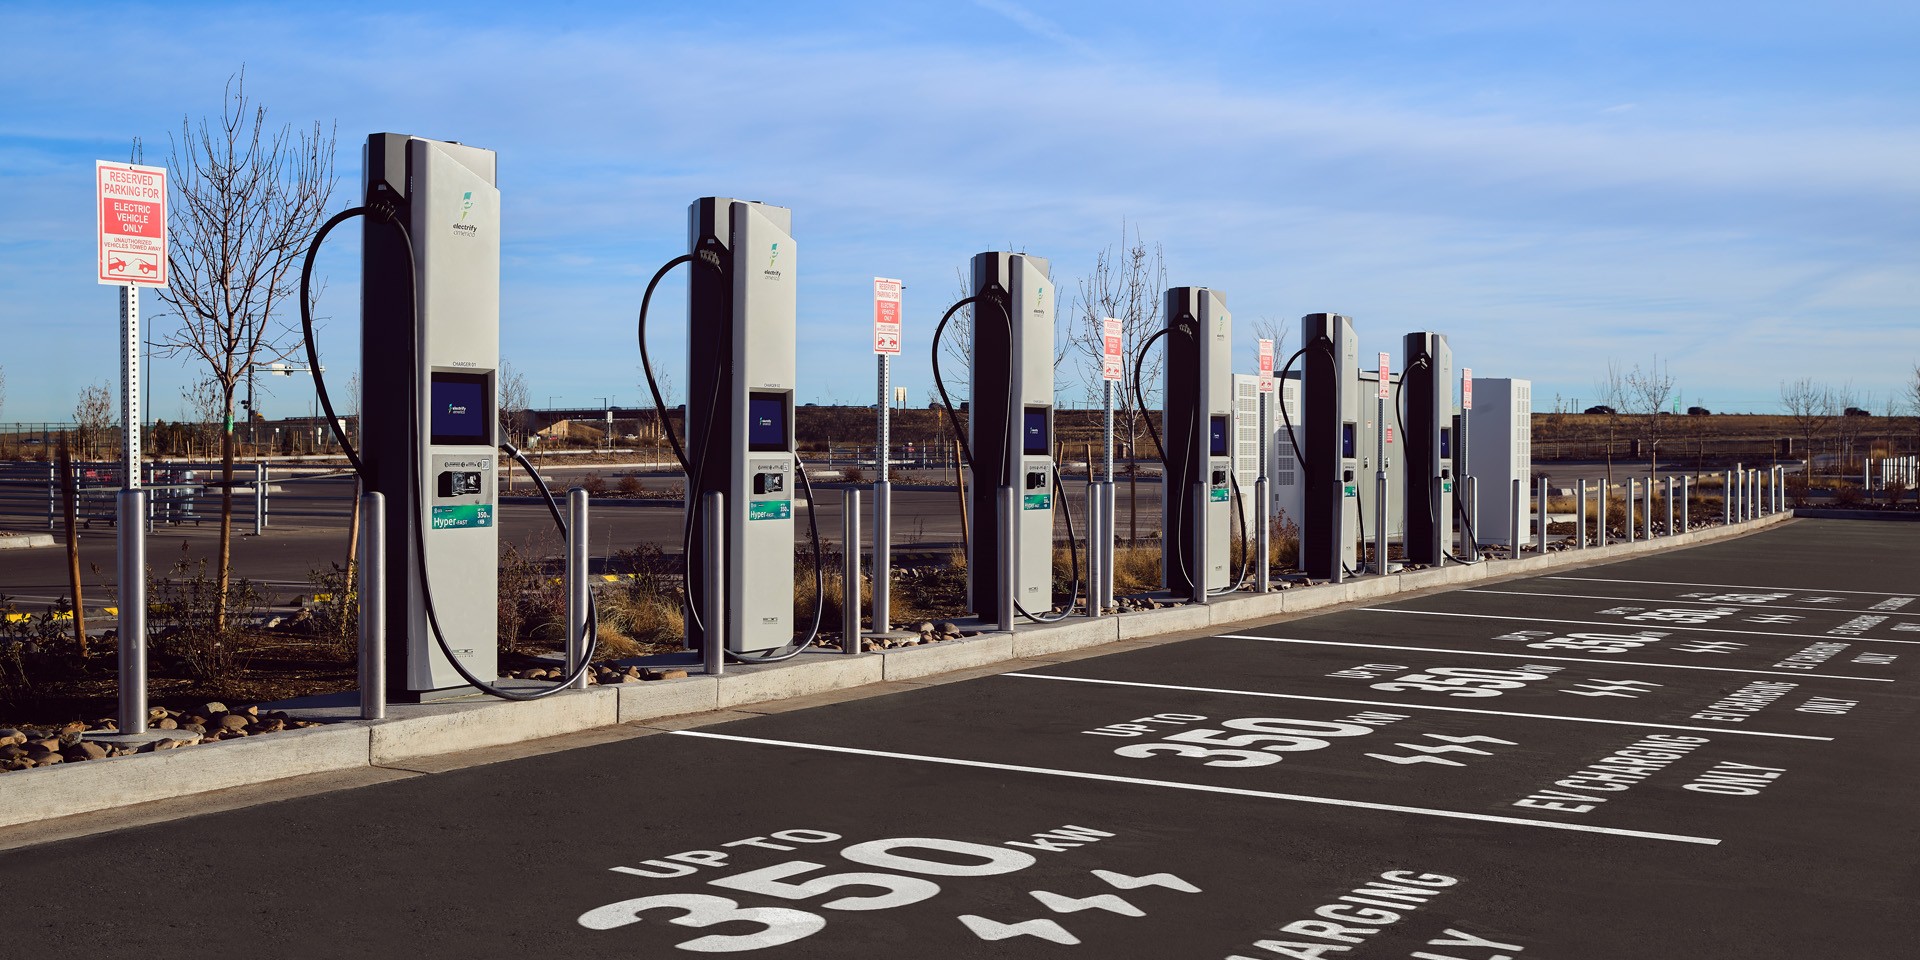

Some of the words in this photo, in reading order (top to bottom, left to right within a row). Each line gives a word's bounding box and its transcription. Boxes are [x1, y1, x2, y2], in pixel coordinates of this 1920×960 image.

[110, 171, 153, 186] RESERVED
[104, 183, 141, 197] PARKING
[142, 187, 160, 199] FOR
[114, 202, 151, 214] ELECTRIC
[116, 212, 149, 224] VEHICLE
[122, 223, 143, 233] ONLY
[453, 223, 477, 233] electrify
[104, 241, 129, 250] VEHICLES
[113, 237, 153, 246] UNAUTHORIZED
[1526, 632, 1661, 654] 350
[1370, 667, 1549, 698] 350
[1081, 723, 1157, 737] UP
[1129, 713, 1208, 725] TO
[1690, 709, 1750, 722] EV
[1114, 717, 1375, 768] 350
[1554, 734, 1710, 792] CHARGING
[1682, 760, 1787, 796] ONLY
[1512, 789, 1607, 813] EV
[609, 850, 729, 879] UP
[720, 829, 843, 851] TO
[578, 837, 1037, 953] 350
[1224, 868, 1459, 960] ARGING
